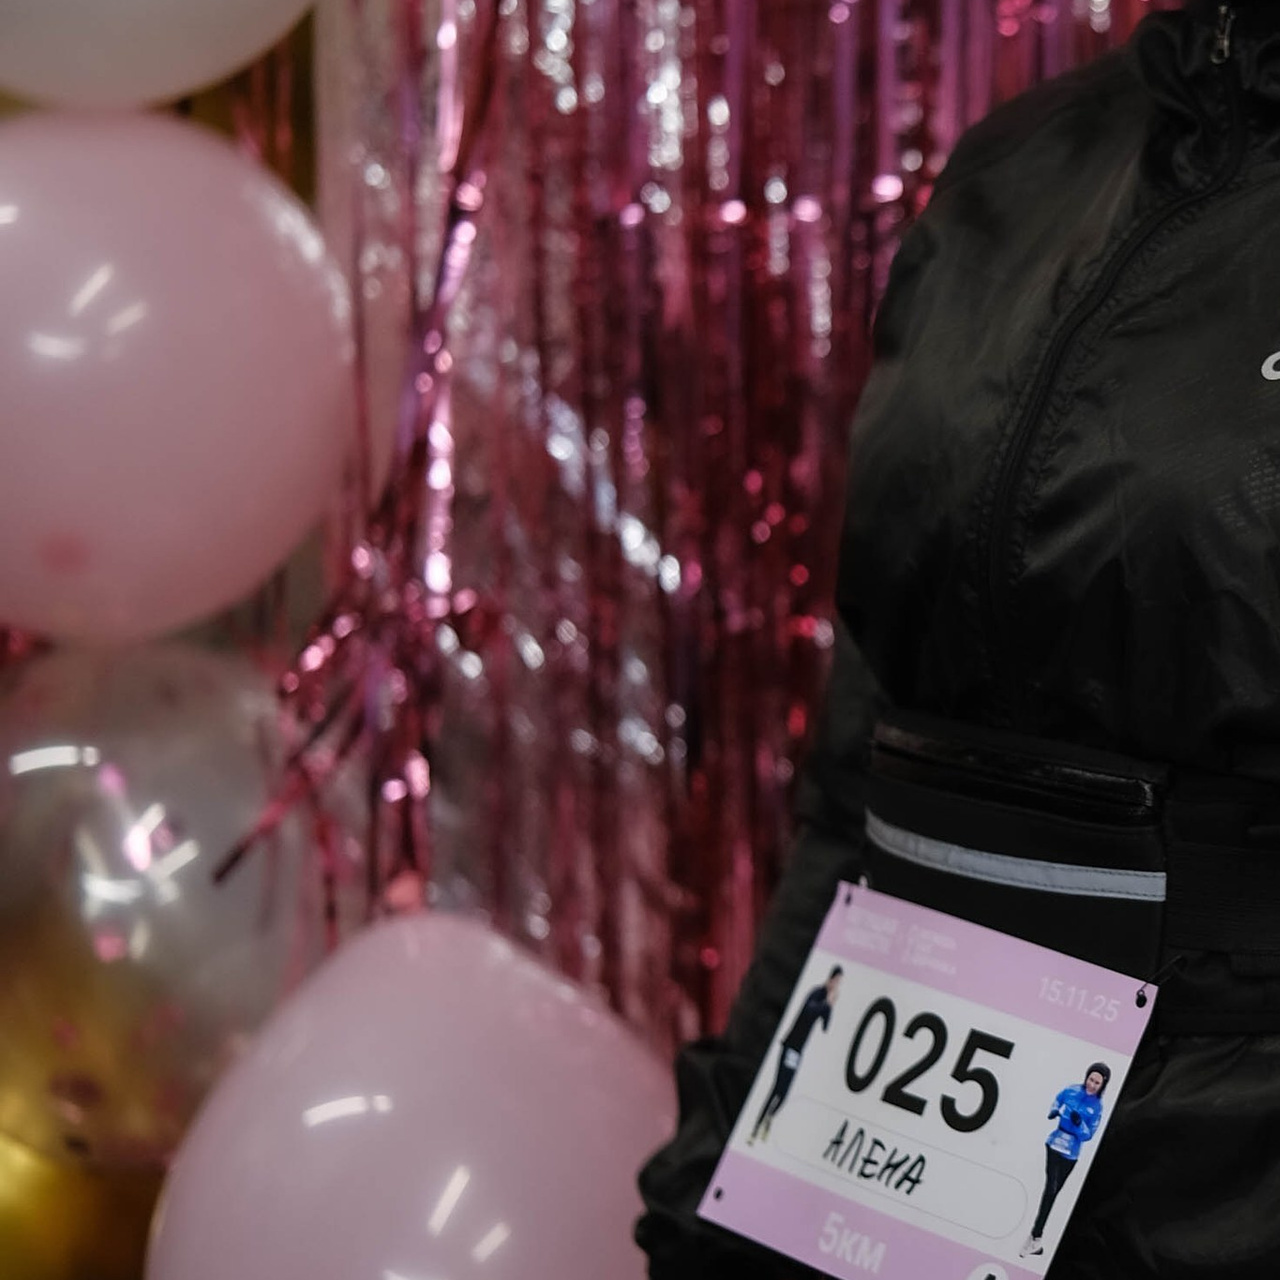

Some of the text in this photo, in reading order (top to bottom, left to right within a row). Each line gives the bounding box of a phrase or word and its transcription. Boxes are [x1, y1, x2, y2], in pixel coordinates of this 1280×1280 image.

[1038, 976, 1121, 1022] 15.11.25
[845, 995, 1015, 1133] 025
[822, 1119, 926, 1196] АЛЕНА
